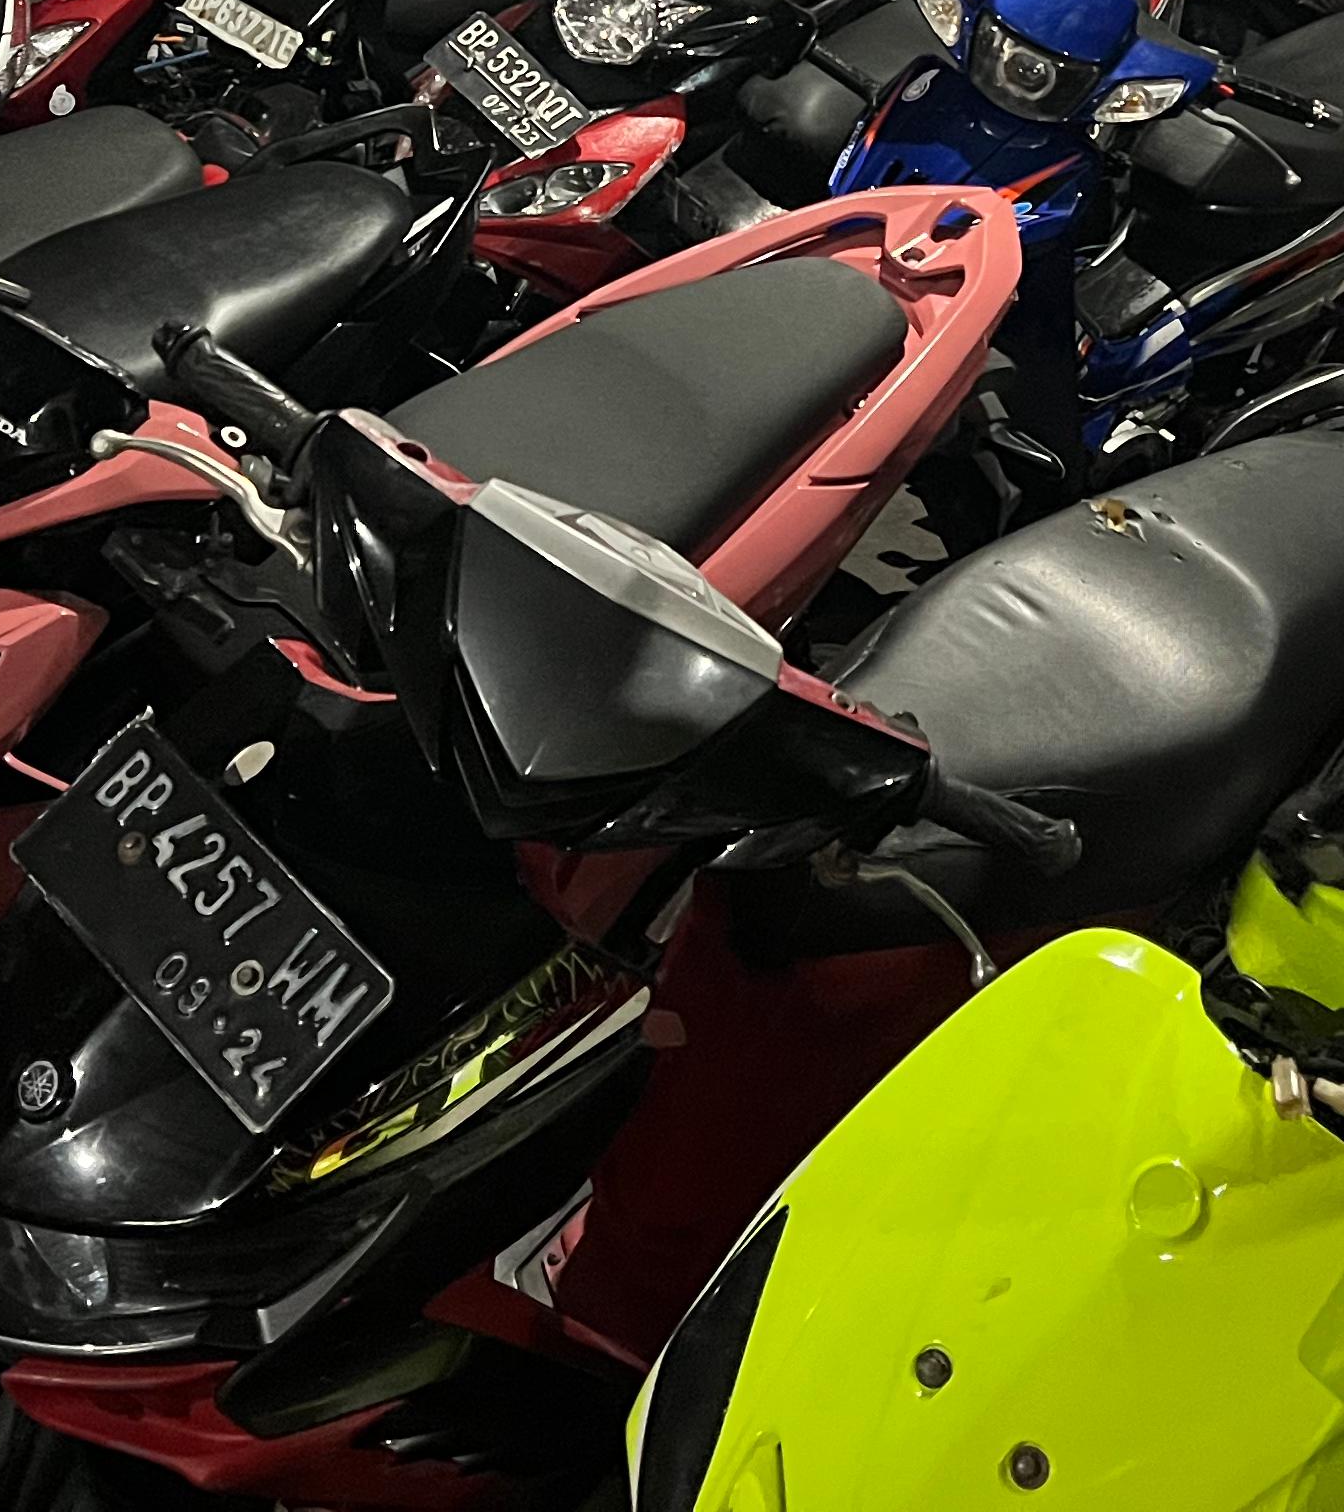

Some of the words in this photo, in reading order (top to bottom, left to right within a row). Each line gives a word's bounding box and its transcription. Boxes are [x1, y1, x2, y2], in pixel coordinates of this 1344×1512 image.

[457, 20, 499, 51] BP
[486, 46, 551, 104] 5321
[94, 749, 173, 827] BP
[152, 813, 282, 946] 4257
[266, 927, 369, 1047] WM
